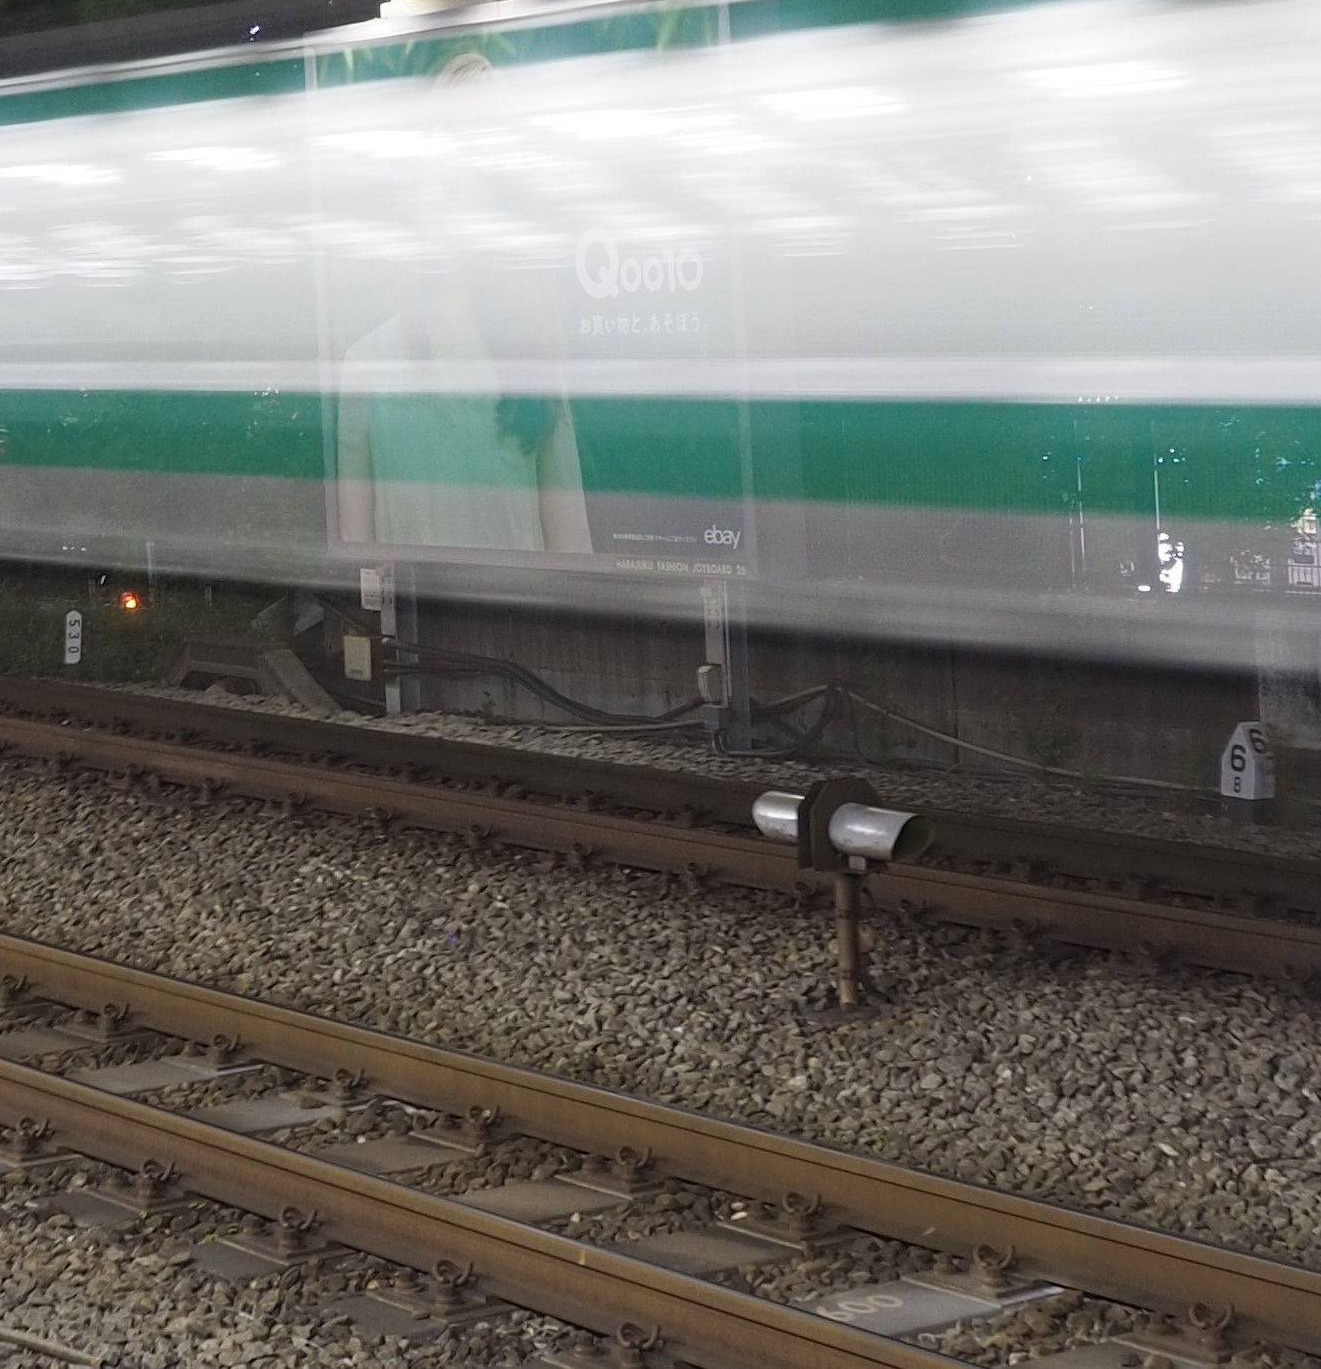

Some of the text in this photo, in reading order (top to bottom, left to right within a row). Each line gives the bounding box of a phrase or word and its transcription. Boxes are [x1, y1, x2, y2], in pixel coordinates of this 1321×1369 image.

[575, 226, 704, 299] Qoo10
[703, 524, 741, 550] ebay
[657, 560, 689, 573] FASHION
[693, 563, 733, 575] JOYBOARD
[68, 618, 81, 653] 530
[1231, 744, 1246, 772] 6
